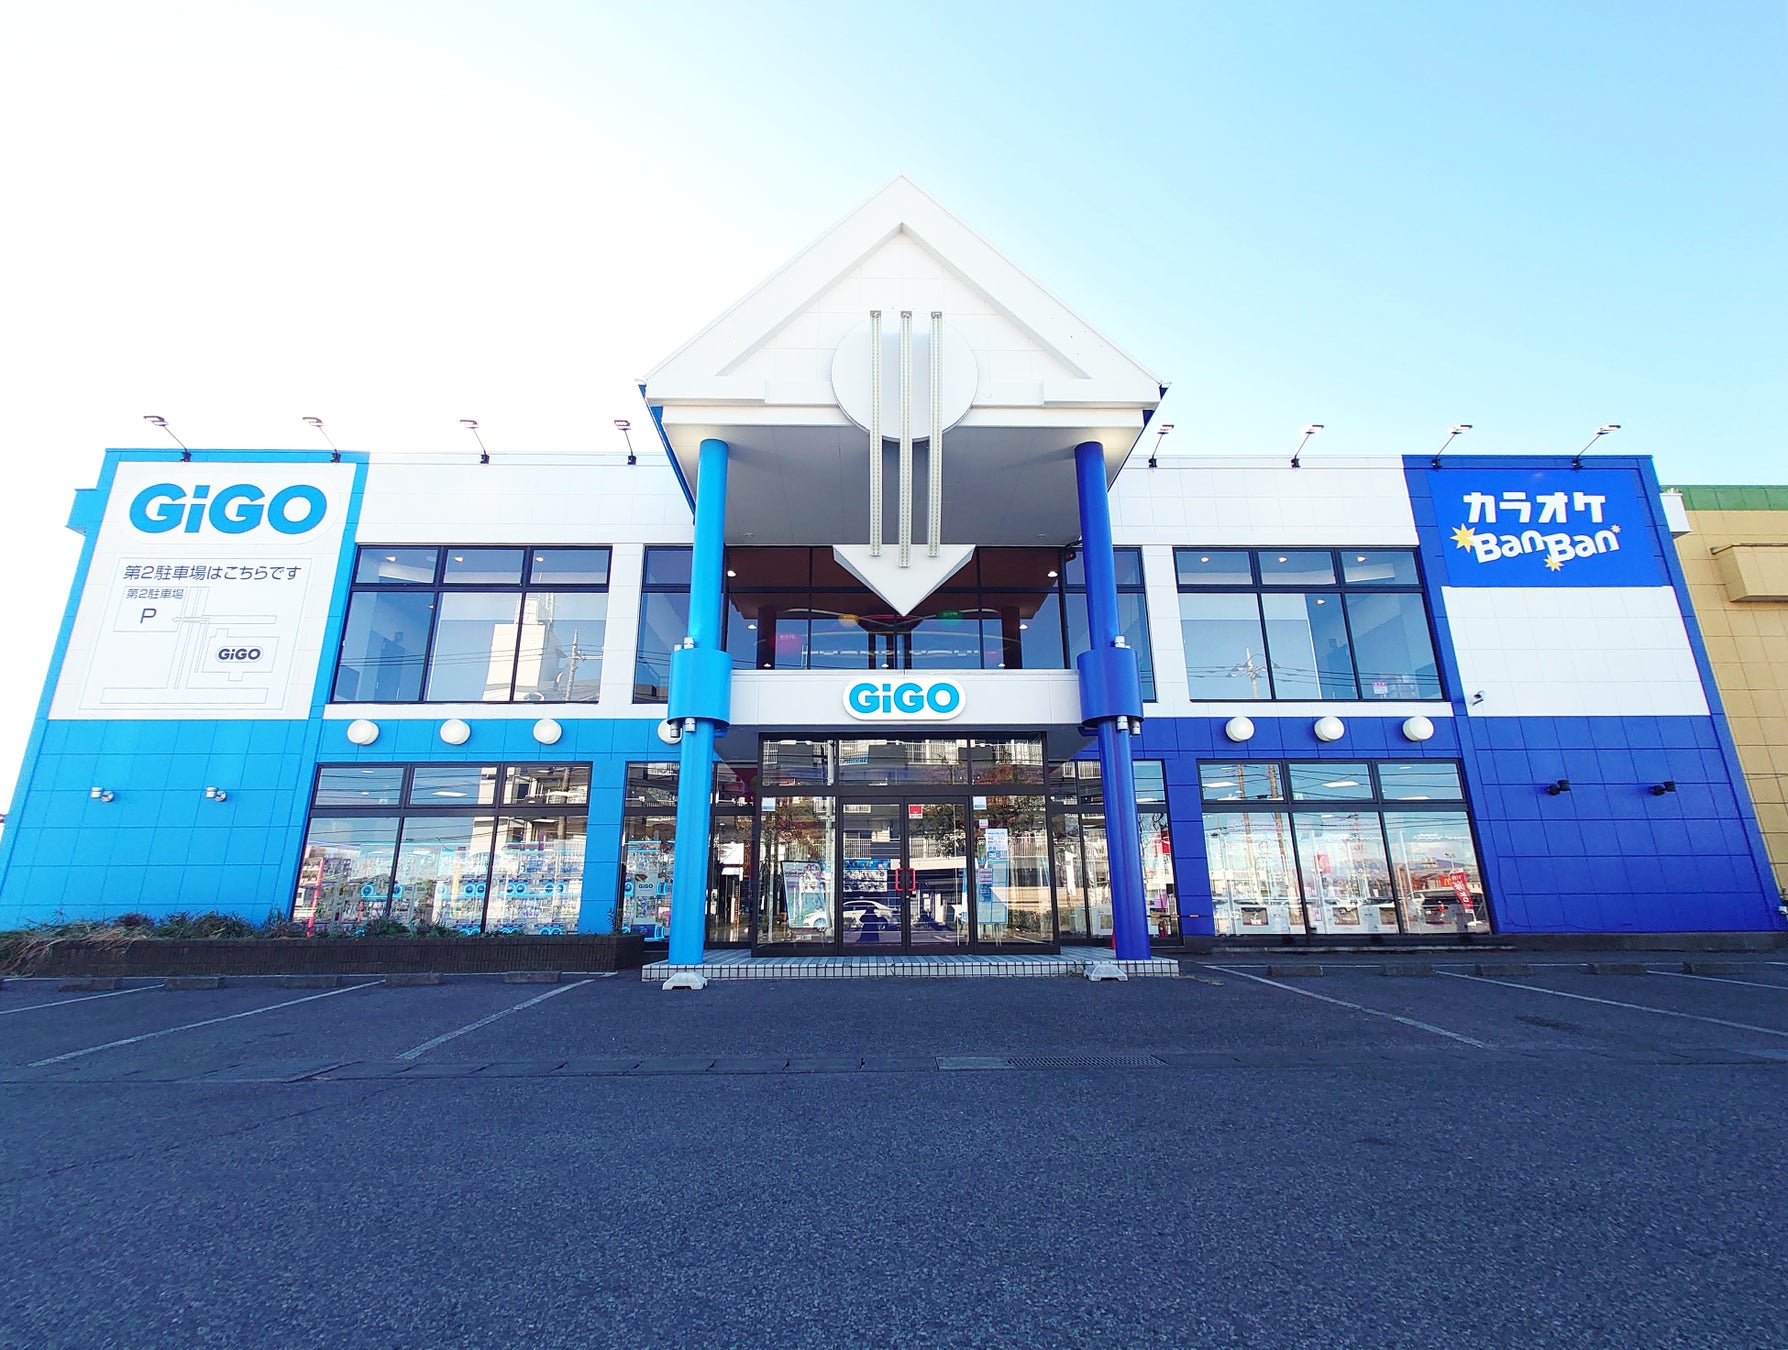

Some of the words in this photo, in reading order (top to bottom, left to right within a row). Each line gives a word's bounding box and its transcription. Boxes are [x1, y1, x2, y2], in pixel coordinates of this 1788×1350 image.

[129, 483, 327, 535] GiGO
[1463, 491, 1606, 523] カラオケ
[123, 565, 302, 581] 第2駐車場はこちらです
[126, 588, 184, 600] 第2駐車場
[140, 608, 157, 624] P
[217, 648, 261, 661] GiGO
[849, 683, 960, 714] GiGO
